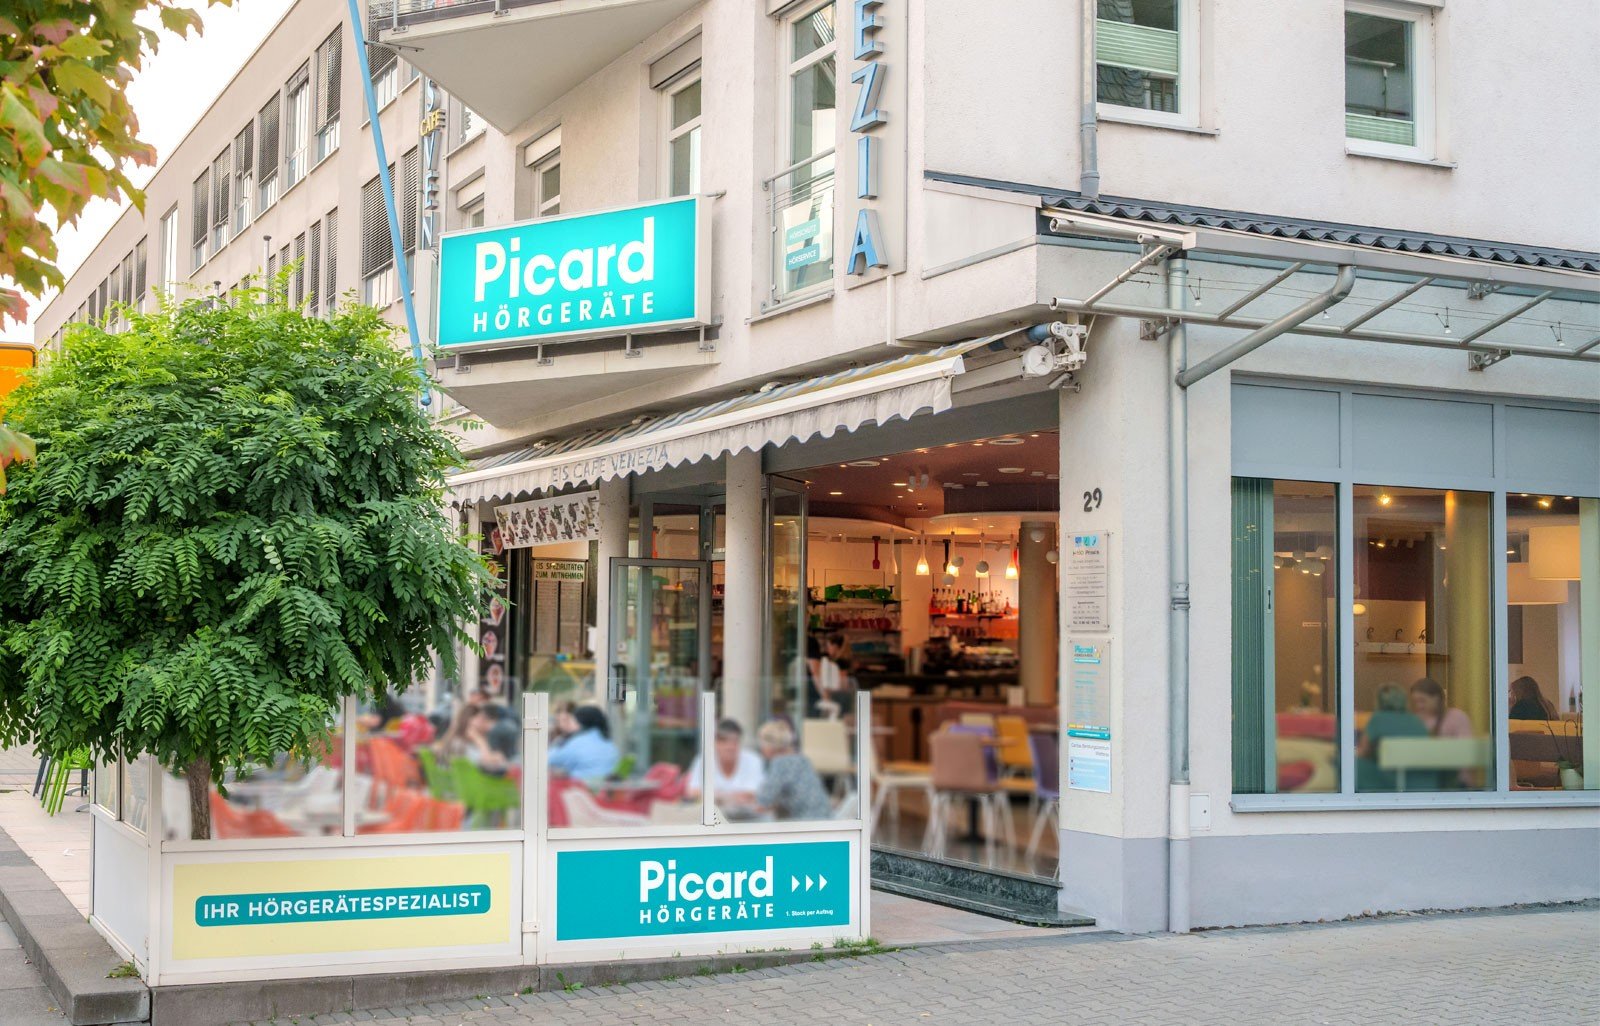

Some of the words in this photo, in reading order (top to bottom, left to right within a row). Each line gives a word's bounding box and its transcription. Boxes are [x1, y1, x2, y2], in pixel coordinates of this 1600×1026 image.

[474, 216, 655, 303] Picard
[473, 291, 654, 333] HÖRGERÄTE
[551, 465, 569, 482] EIS
[611, 444, 669, 472] VENEZIA
[1083, 487, 1103, 513] 29
[535, 570, 548, 578] ZUM
[640, 855, 774, 903] Picard
[203, 903, 239, 919] IHR
[248, 892, 482, 917] HÖRGERÄTESPEZIALIST
[639, 900, 774, 925] HÖRGERÄTE
